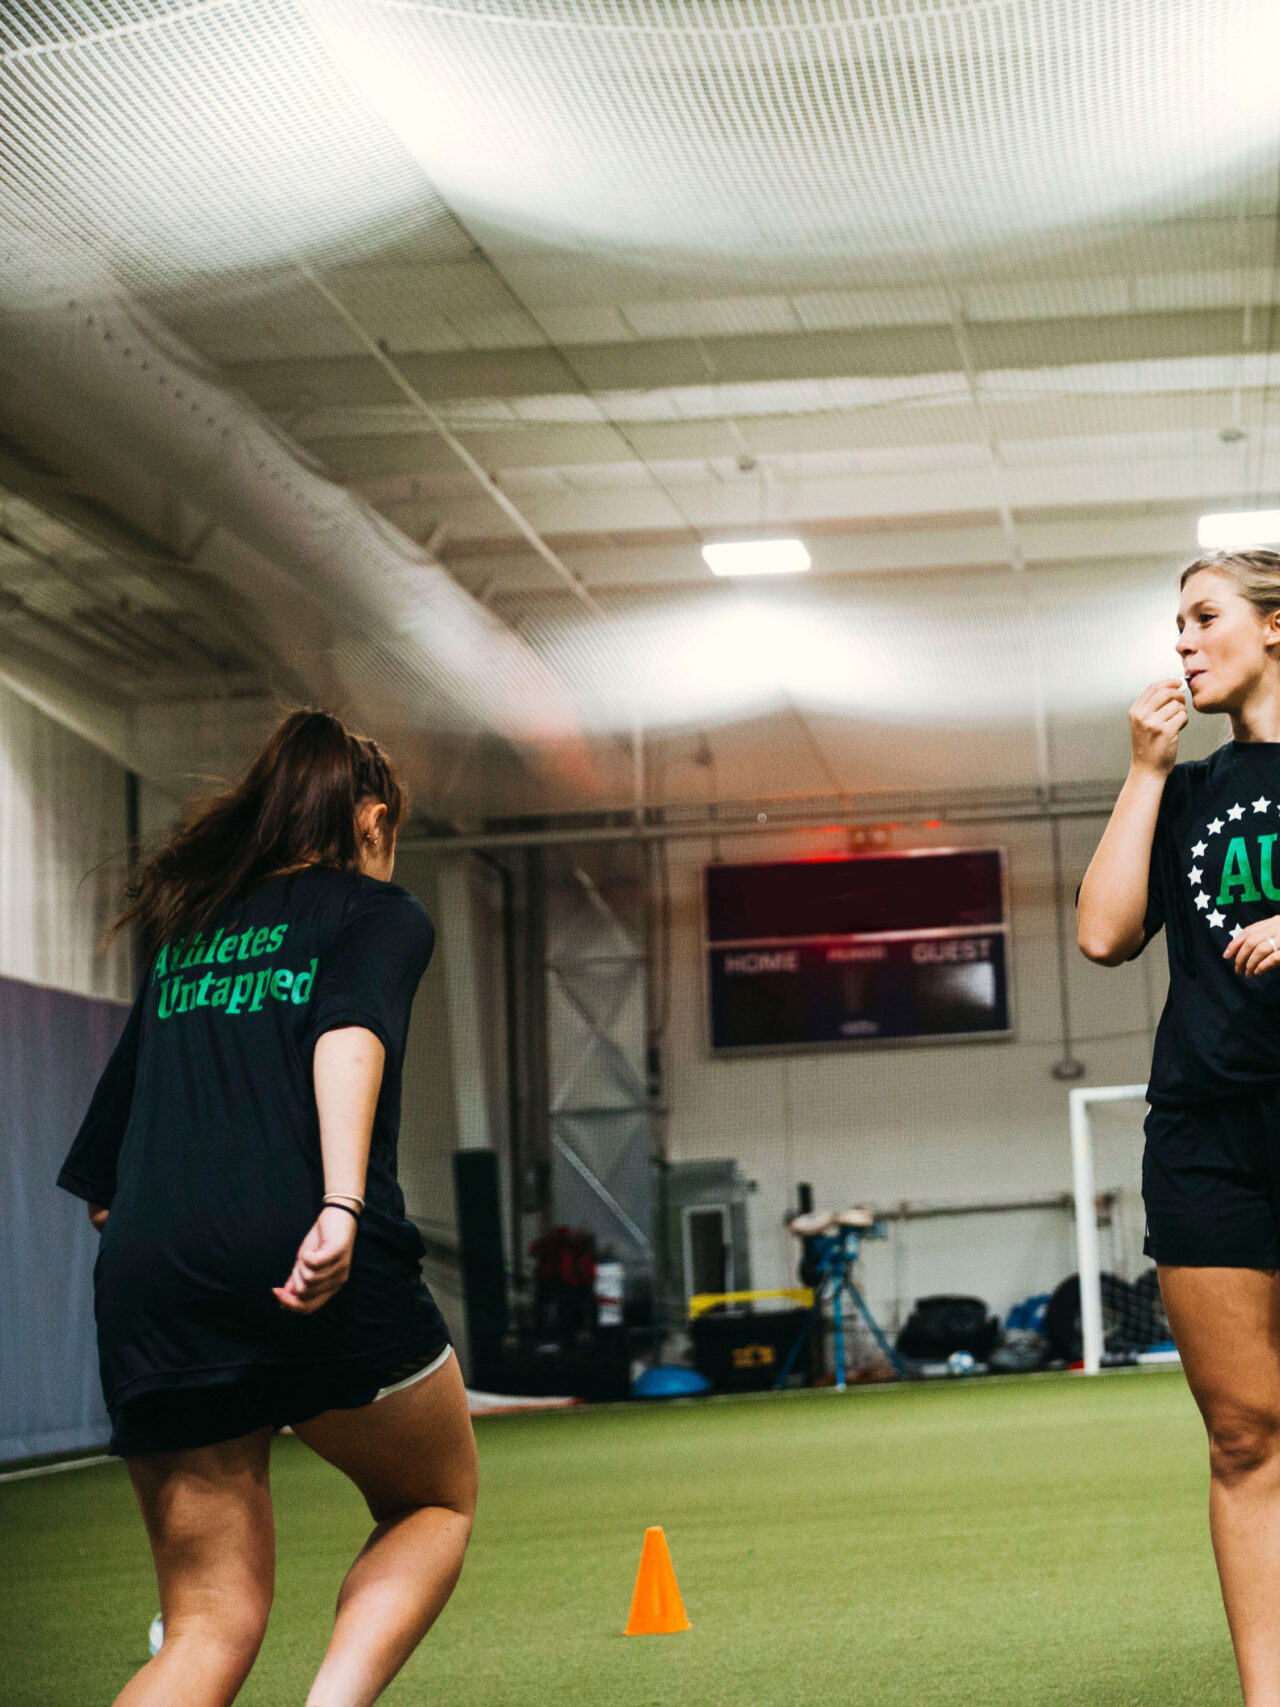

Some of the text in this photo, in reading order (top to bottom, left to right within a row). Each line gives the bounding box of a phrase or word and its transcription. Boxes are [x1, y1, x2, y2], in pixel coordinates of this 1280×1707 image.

[153, 923, 290, 980] Athletes
[724, 949, 800, 974] HOME
[911, 938, 993, 965] GUEST
[157, 957, 319, 1020] Untapped
